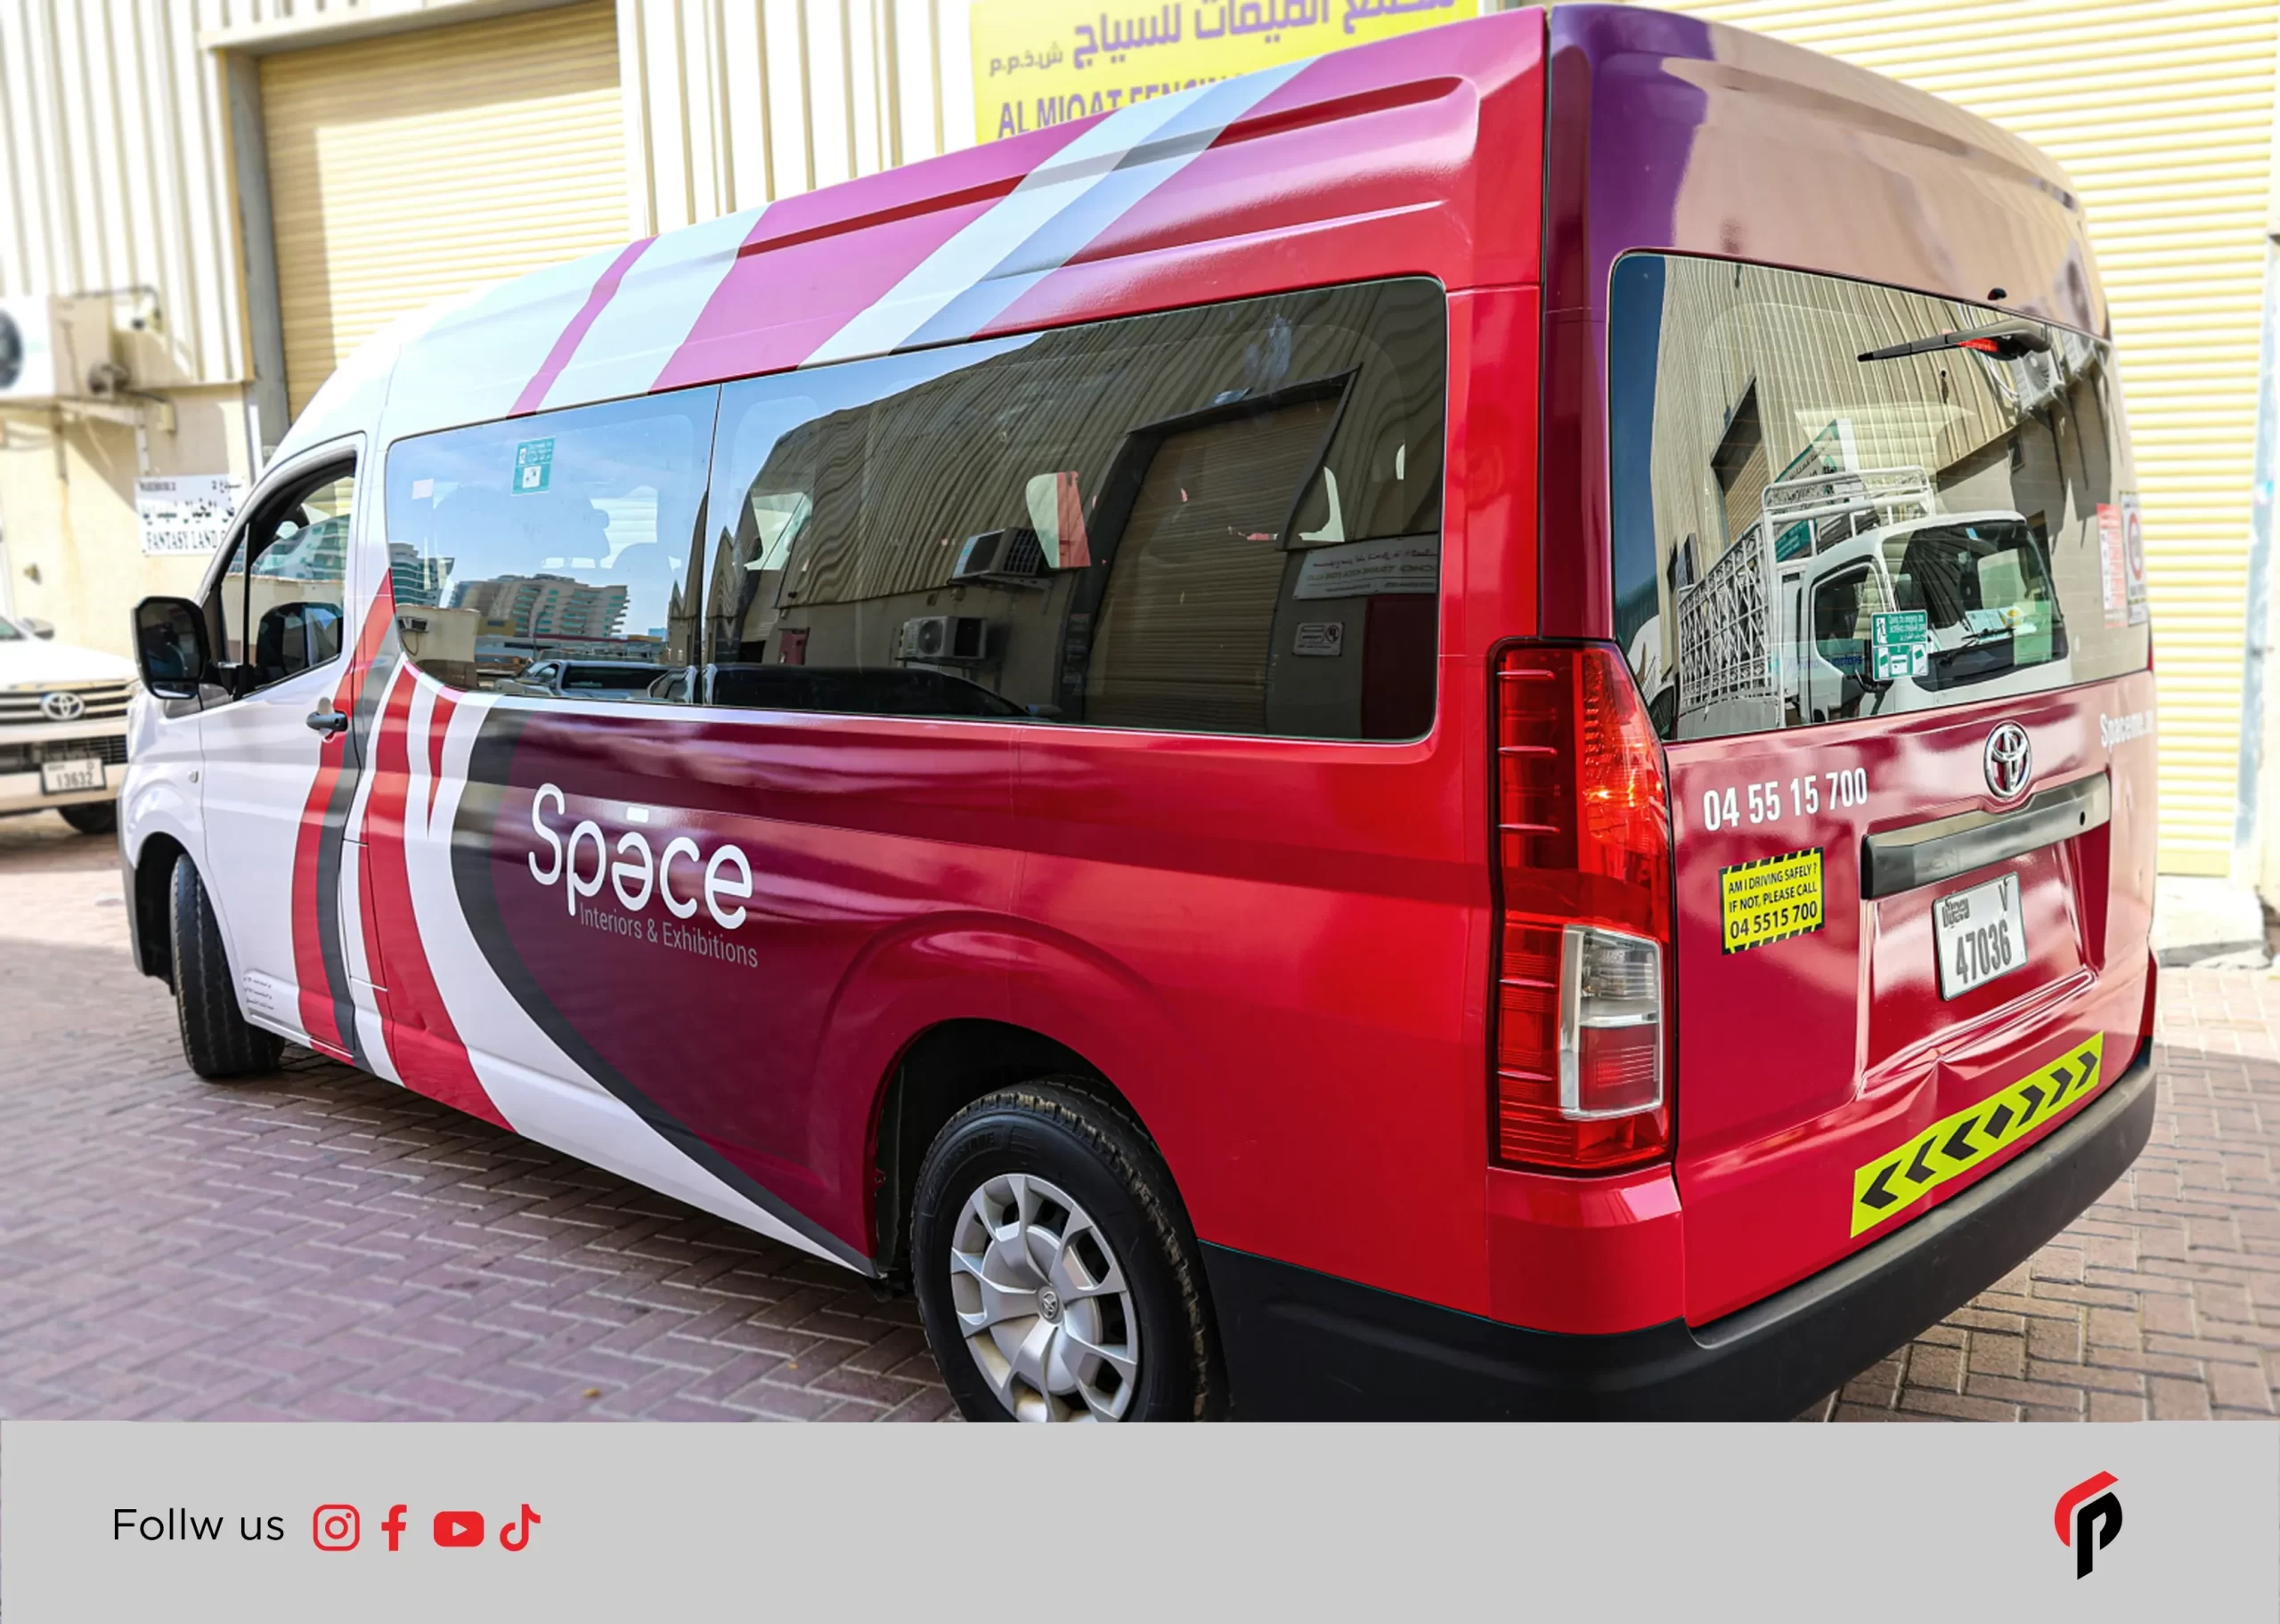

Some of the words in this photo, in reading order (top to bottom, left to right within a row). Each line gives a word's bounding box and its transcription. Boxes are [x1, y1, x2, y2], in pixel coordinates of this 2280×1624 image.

[1072, 3, 1181, 69] للسياج
[998, 101, 1030, 139] AL
[191, 531, 217, 548] LAND
[1703, 787, 1739, 831] 04
[1747, 781, 1780, 824] 55
[1790, 775, 1819, 816] 15
[1826, 767, 1868, 810] 700
[1729, 879, 1743, 894] AM
[1749, 870, 1783, 889] DRIVING
[1784, 864, 1812, 881] SAFELY
[1730, 899, 1738, 914] IF
[1739, 894, 1761, 911] NOT,
[1763, 886, 1796, 905] PLEASE
[1796, 881, 1817, 897] CALL
[580, 902, 642, 939] Interiors
[647, 919, 657, 943] &
[663, 922, 758, 968] Exhibitions
[1730, 918, 1749, 939] 04
[1753, 907, 1788, 934] 5515
[1792, 900, 1818, 923] 700
[1956, 918, 2011, 984] 47036
